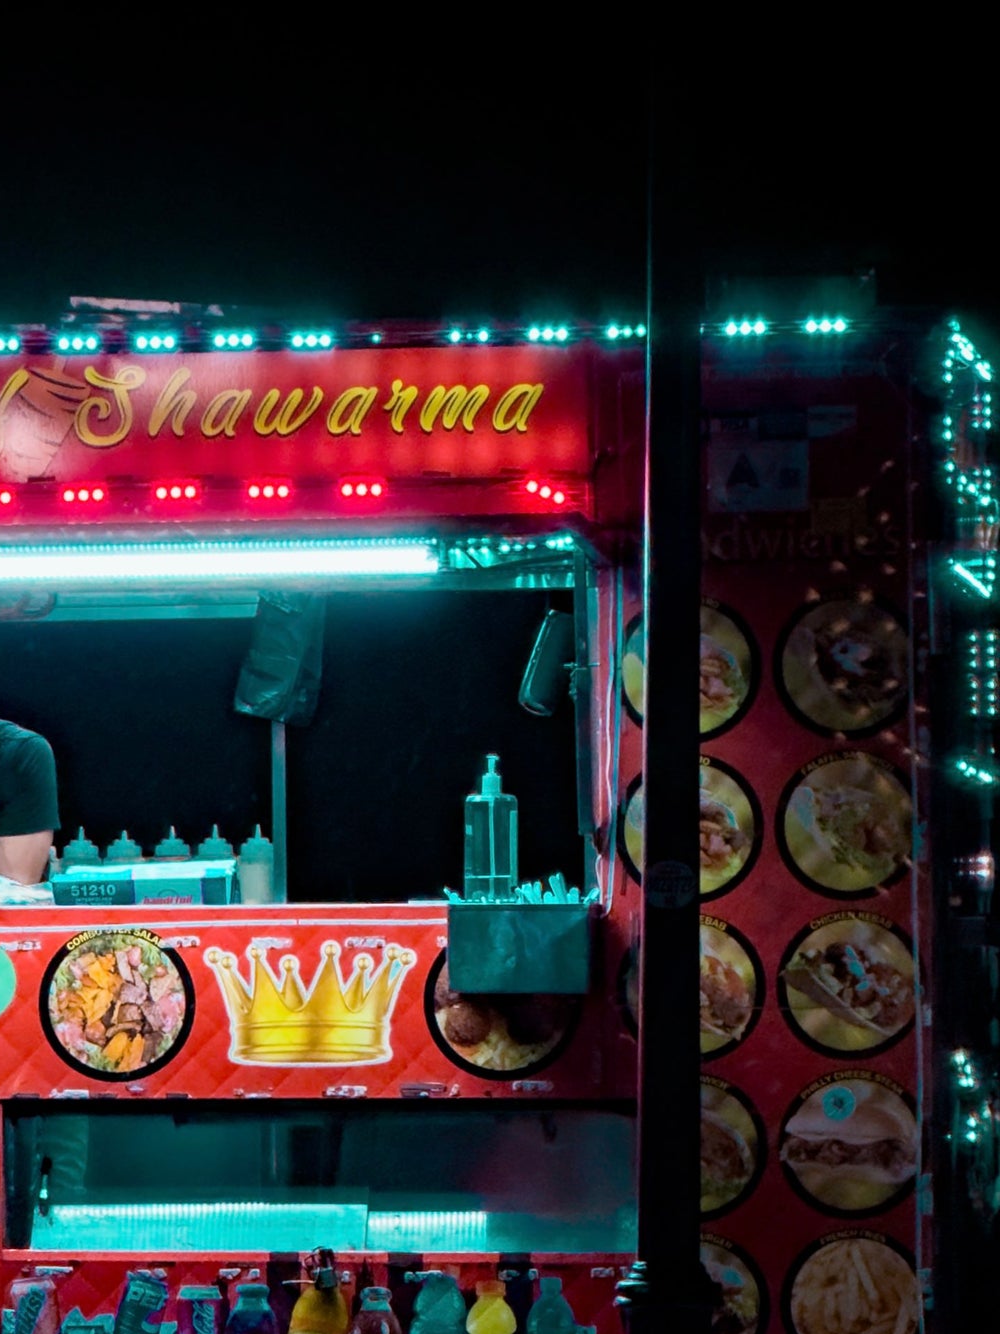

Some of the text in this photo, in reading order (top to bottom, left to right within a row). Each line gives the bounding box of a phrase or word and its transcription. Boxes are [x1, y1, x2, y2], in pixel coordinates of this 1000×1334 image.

[73, 365, 545, 448] Shawarma
[70, 883, 118, 897] 51210
[700, 916, 728, 932] EBAB
[809, 911, 894, 930] CHICKEN KEBAB
[66, 930, 103, 951] COMBO
[834, 1069, 873, 1081] CHEESE
